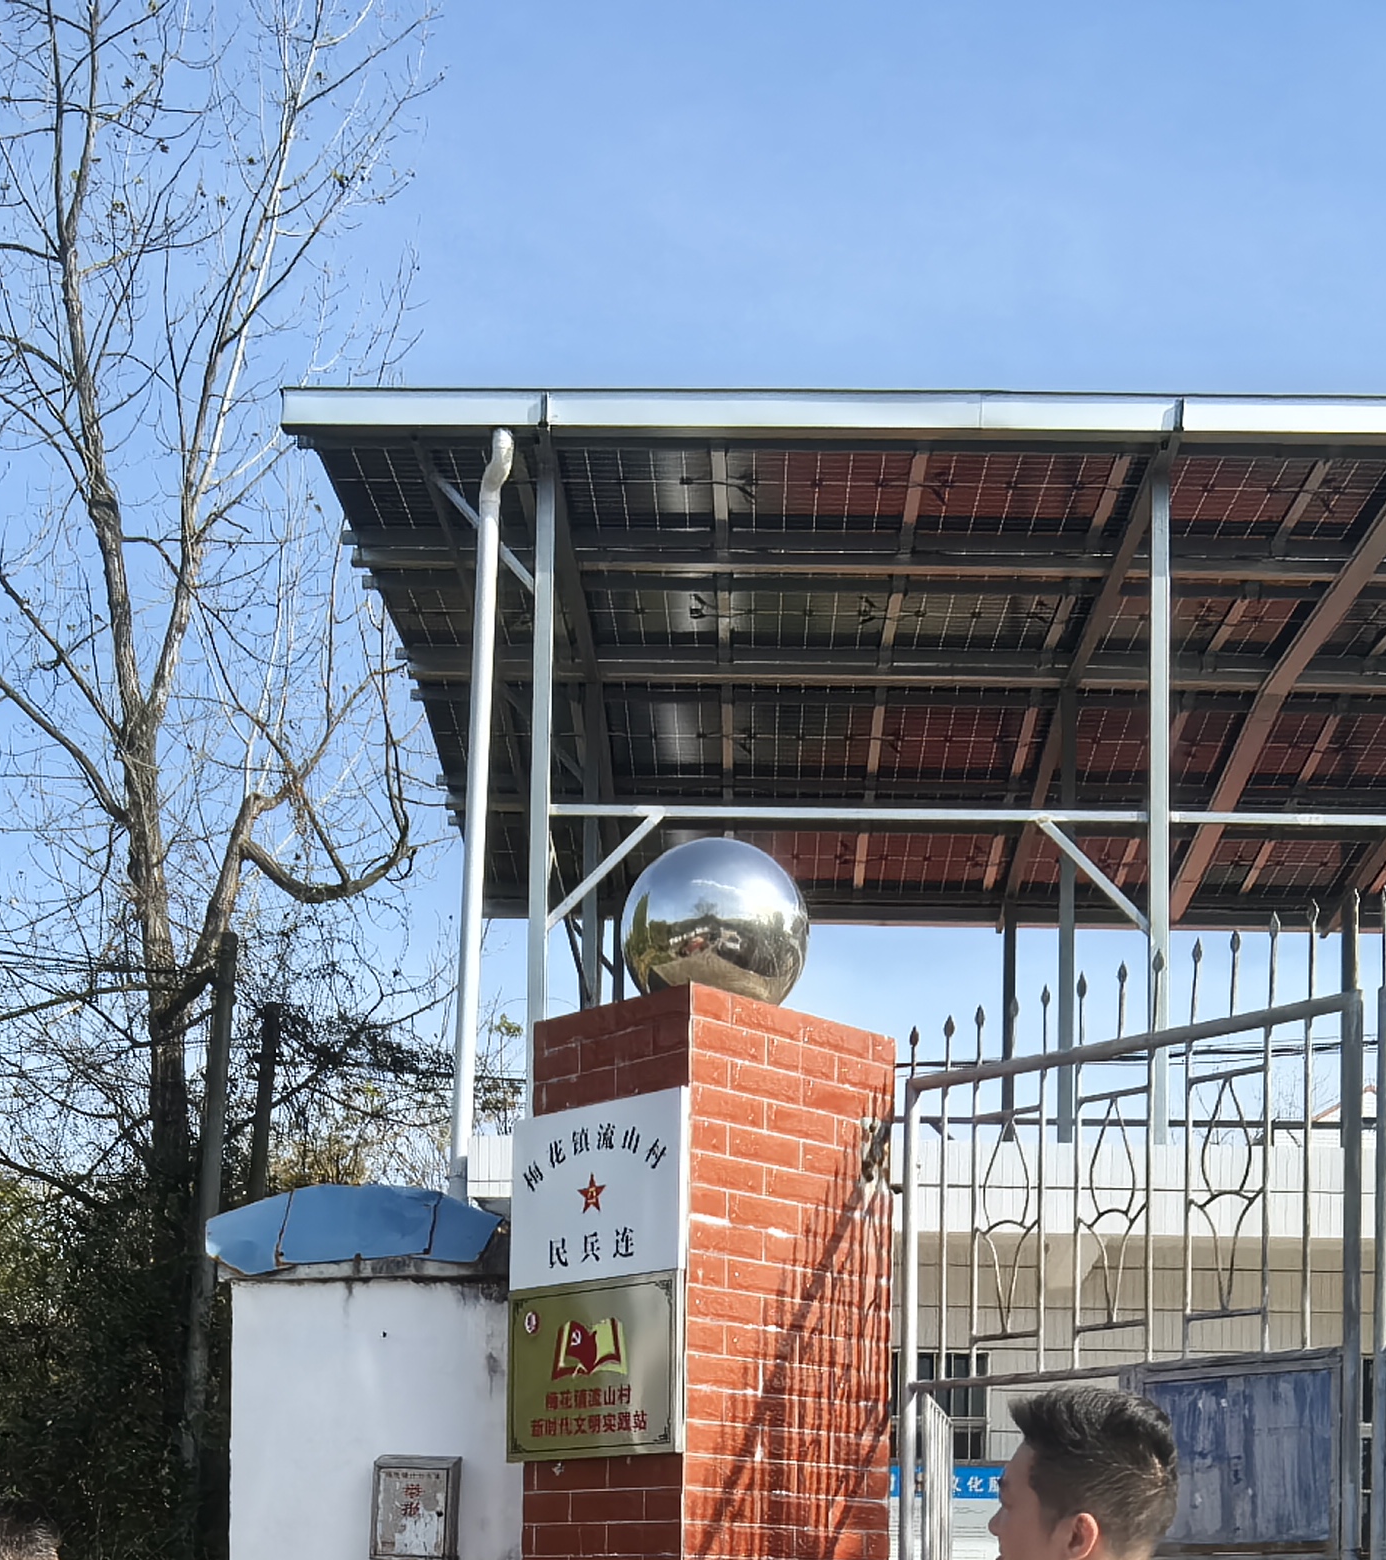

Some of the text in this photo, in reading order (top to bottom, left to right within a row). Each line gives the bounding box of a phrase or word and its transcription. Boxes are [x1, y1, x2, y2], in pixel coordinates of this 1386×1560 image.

[523, 1122, 668, 1193] 梅花镇流山村
[548, 1226, 635, 1270] 民兵连
[545, 1383, 632, 1411] 梅花镇流山村
[530, 1410, 648, 1438] 新时代文明实践站
